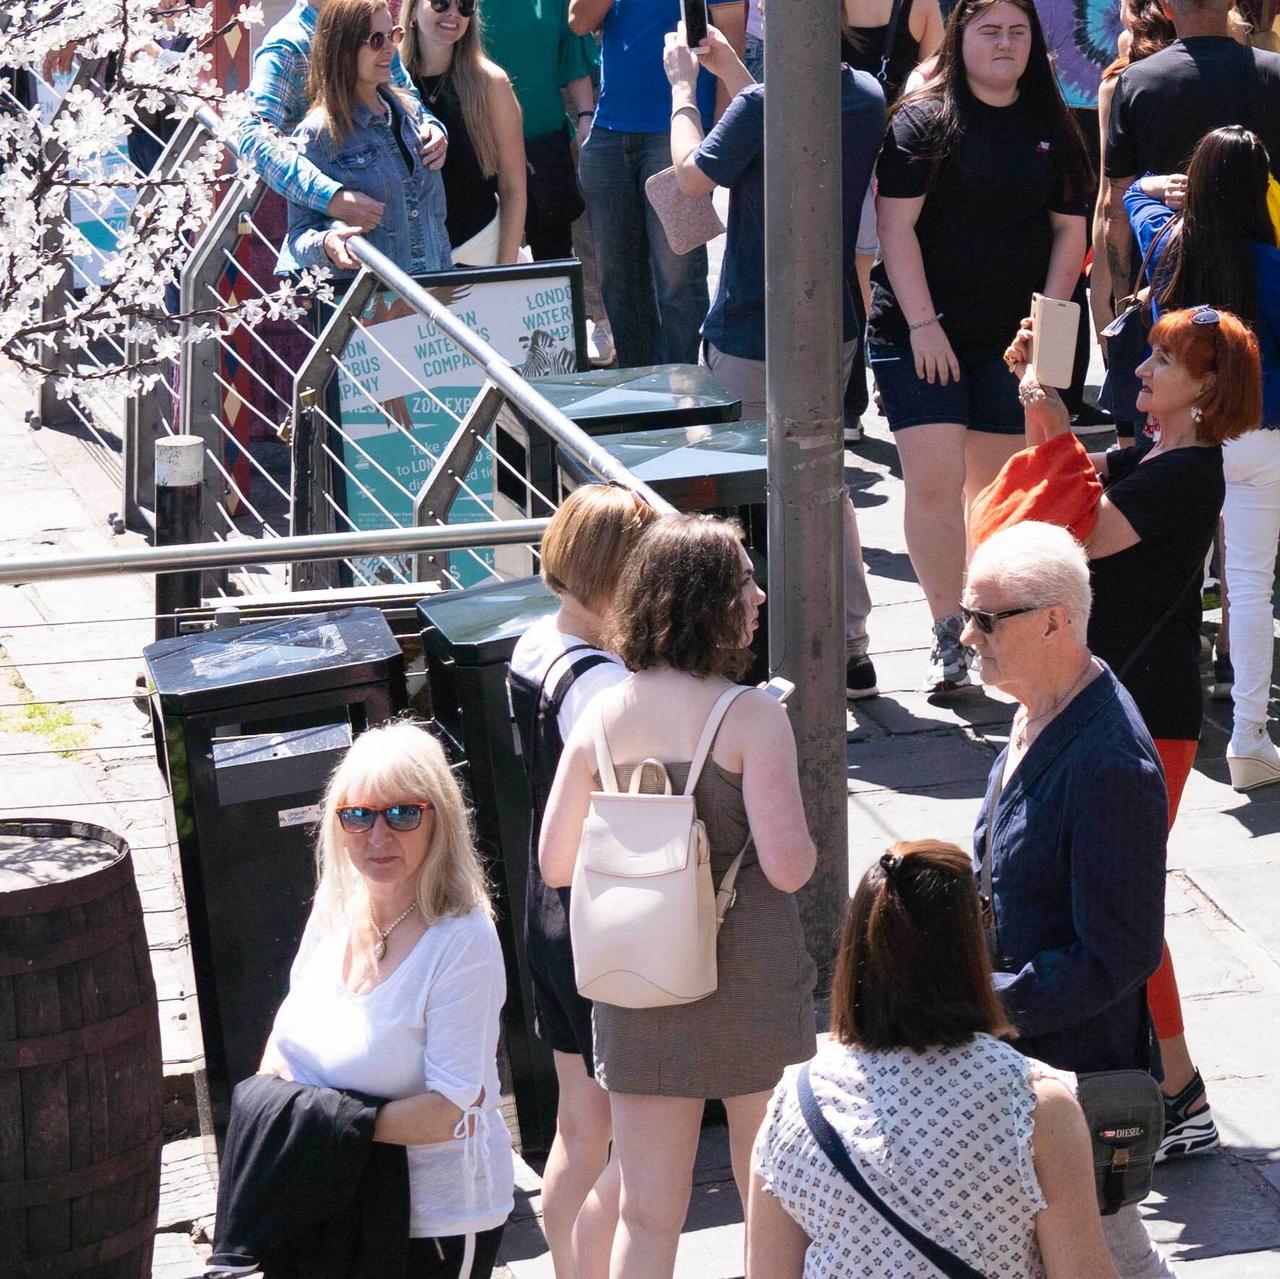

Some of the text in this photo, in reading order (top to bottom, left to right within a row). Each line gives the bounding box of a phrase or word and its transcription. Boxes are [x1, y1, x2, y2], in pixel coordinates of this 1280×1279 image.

[417, 309, 478, 340] LOON
[423, 352, 477, 378] COMPA
[410, 441, 440, 459] Take
[396, 464, 410, 477] to
[1115, 1126, 1142, 1139] DIESEL
